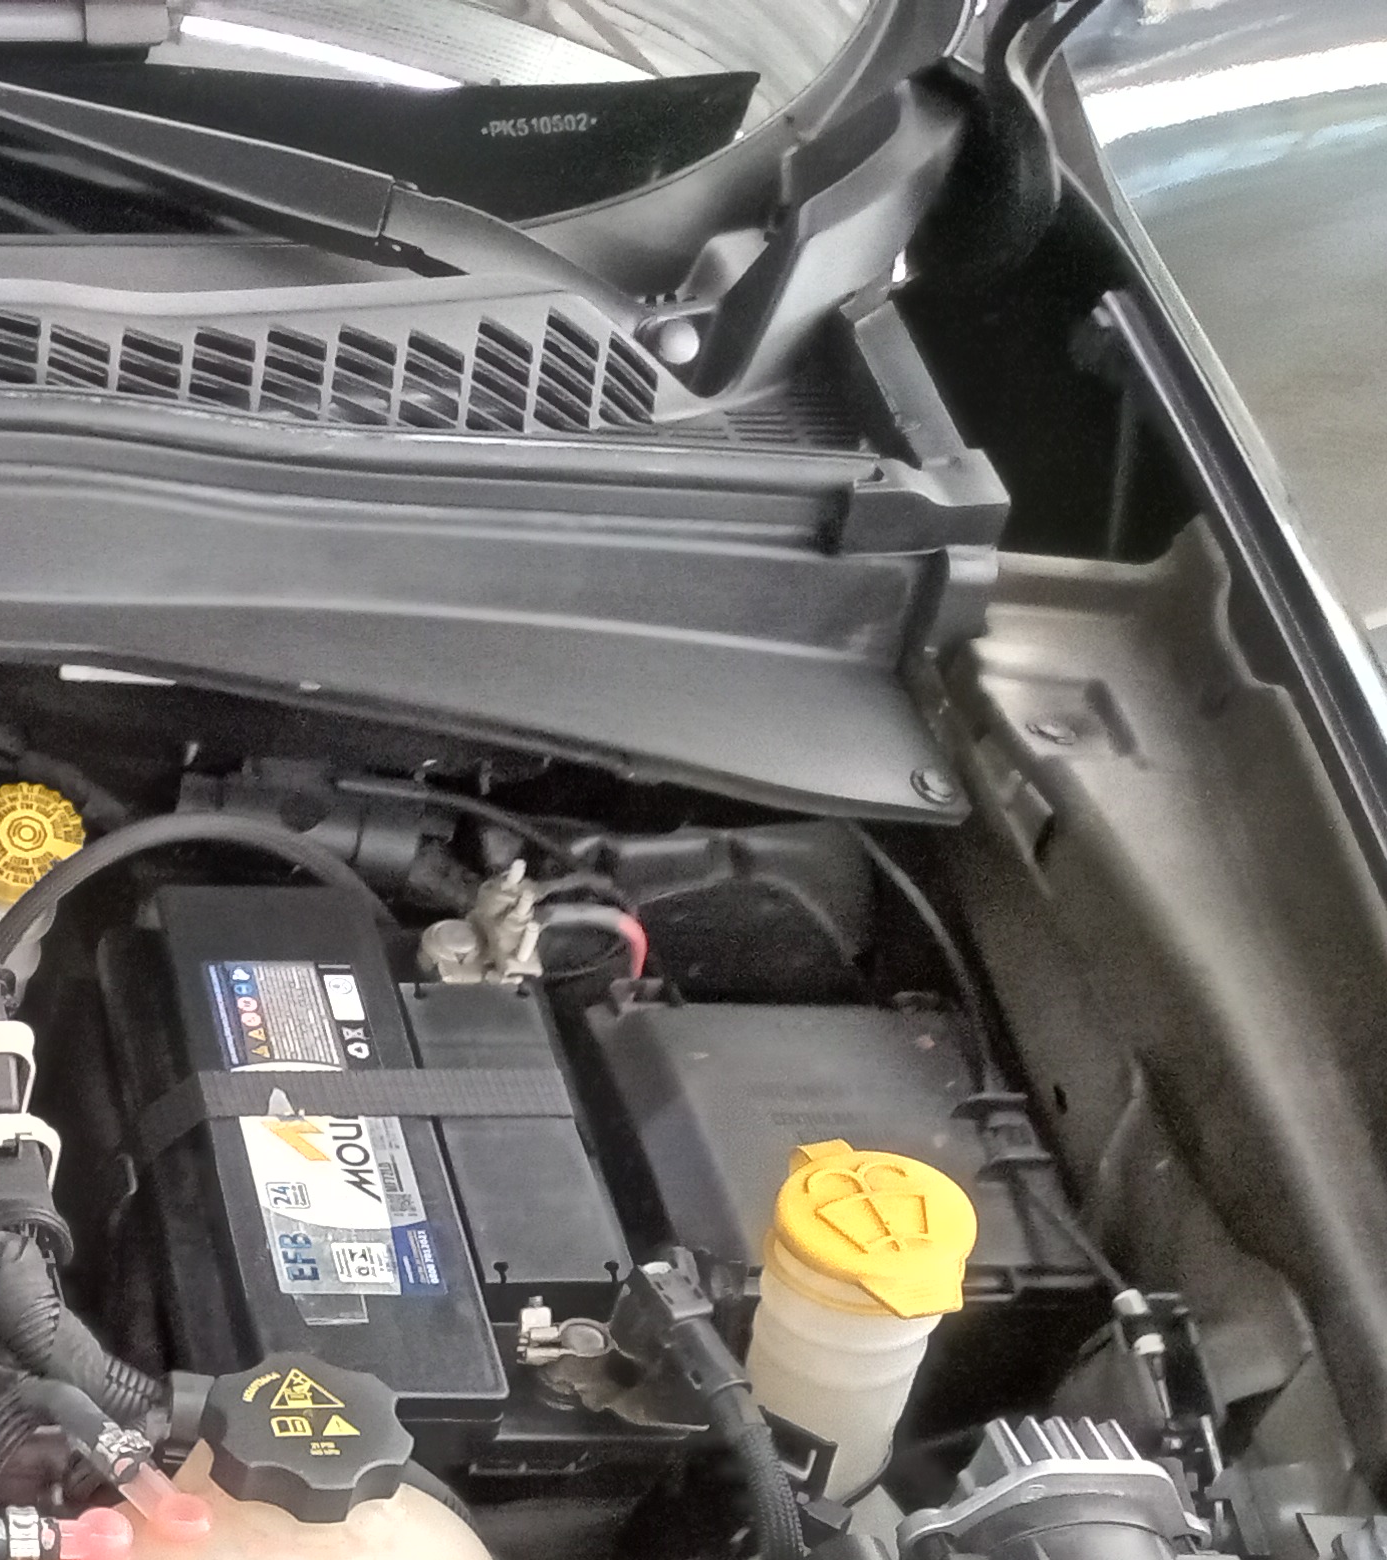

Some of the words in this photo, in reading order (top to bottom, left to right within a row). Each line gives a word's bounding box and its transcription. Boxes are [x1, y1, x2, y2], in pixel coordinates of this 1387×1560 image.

[329, 1116, 382, 1203] MOU
[273, 1186, 292, 1206] 24
[278, 1232, 321, 1281] EFB
